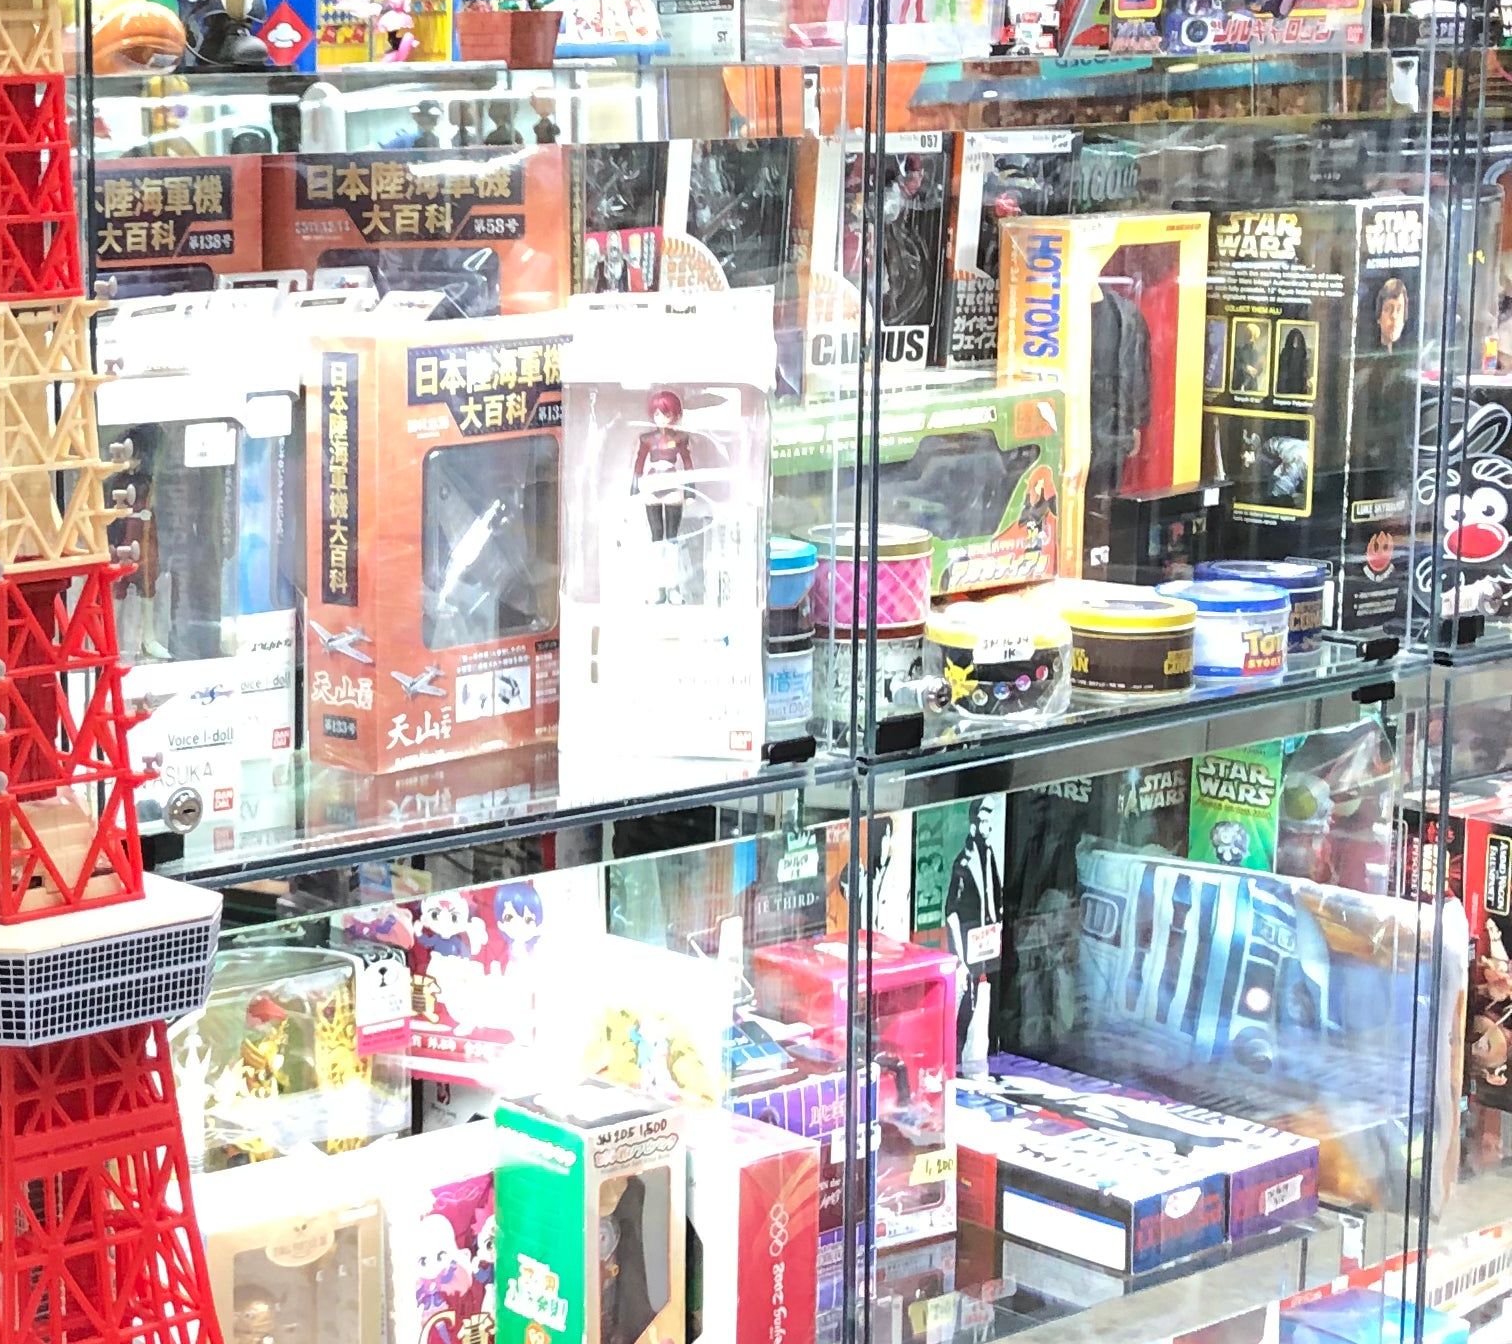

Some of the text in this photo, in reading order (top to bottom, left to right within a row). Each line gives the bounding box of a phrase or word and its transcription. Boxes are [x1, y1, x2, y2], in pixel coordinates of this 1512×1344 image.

[919, 134, 939, 149] 057
[94, 174, 224, 220] 陸海軍機
[361, 202, 455, 237] 大百科
[1217, 211, 1303, 237] STAR
[1366, 210, 1422, 235] STAR
[96, 219, 177, 255] 大百科
[1217, 234, 1302, 260] WARS
[1366, 231, 1422, 255] WARS
[1023, 234, 1063, 359] HOT TOYS
[459, 391, 528, 431] 大百科
[167, 726, 234, 747] Voice I-doll
[1139, 769, 1187, 793] STAR
[1197, 755, 1276, 786] STAR
[1138, 787, 1188, 813] WARS
[1198, 772, 1276, 807] WARS
[772, 1260, 786, 1306] 2008
